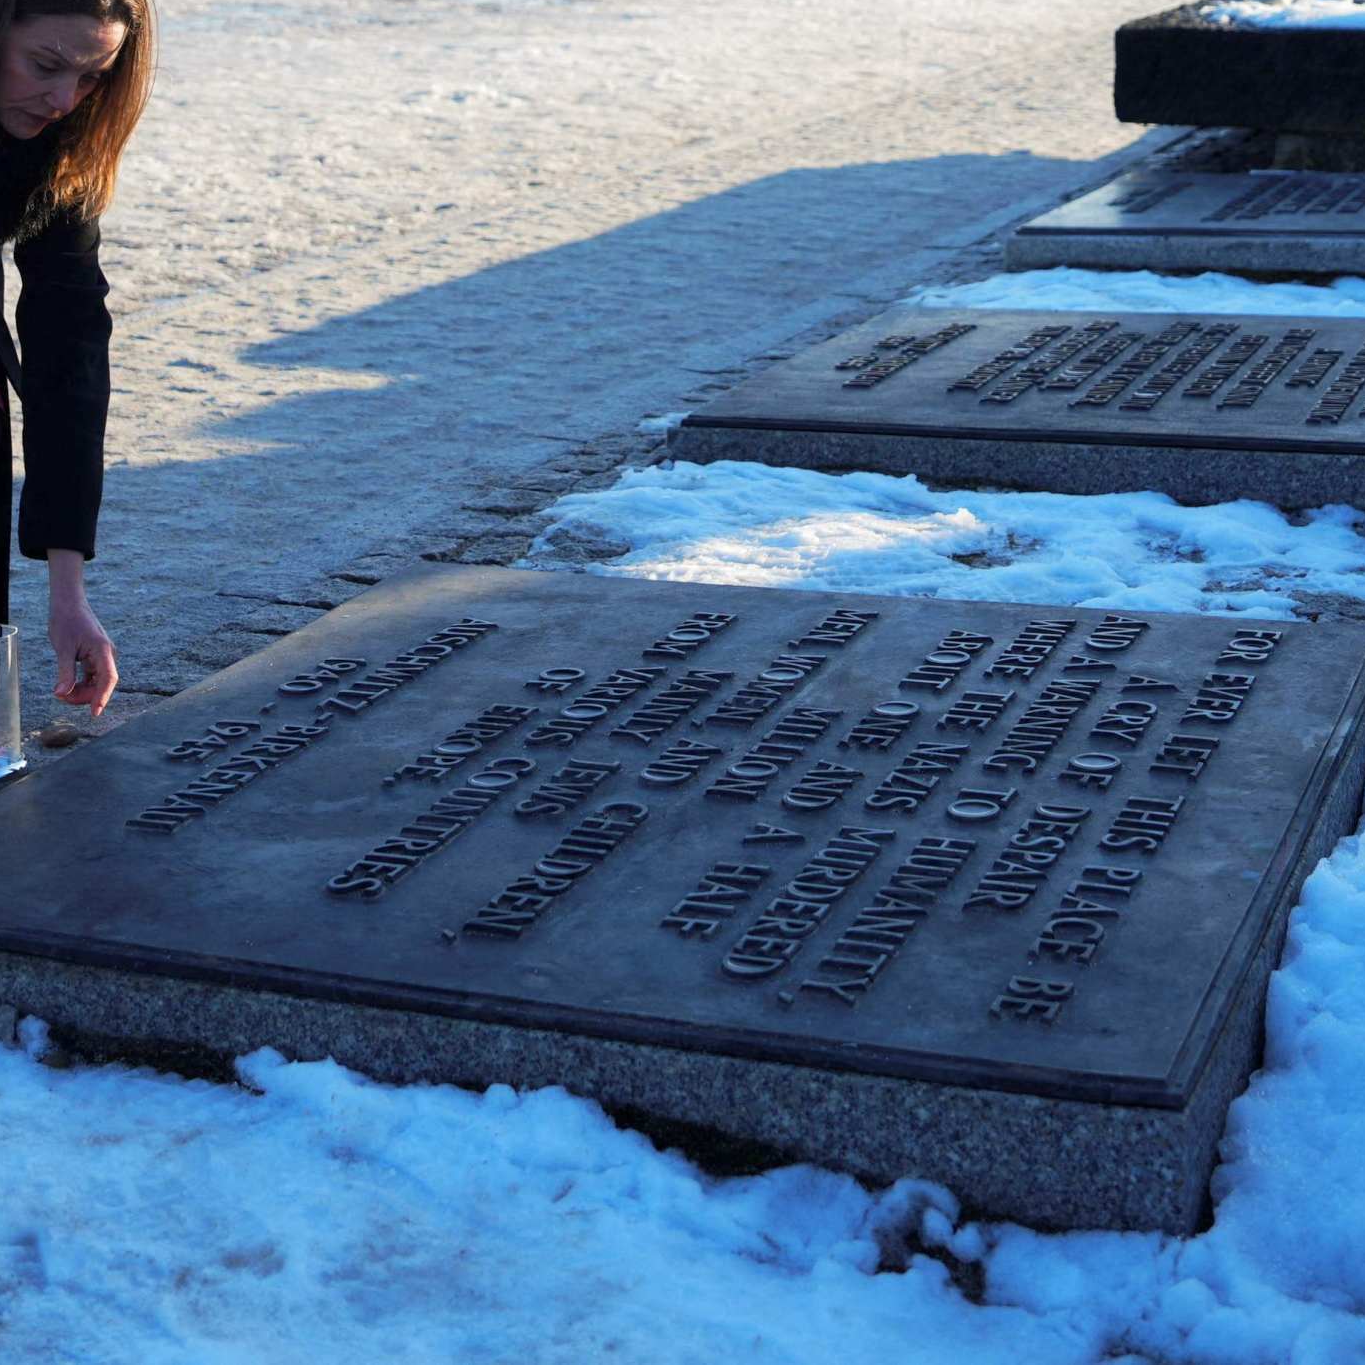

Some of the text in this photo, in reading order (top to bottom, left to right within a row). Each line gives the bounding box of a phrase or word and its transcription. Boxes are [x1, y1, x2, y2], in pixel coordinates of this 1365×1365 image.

[166, 719, 263, 763] 1945
[276, 656, 366, 695] 1940
[329, 611, 738, 898] FROM VARIOUS COUNTRIES
[381, 667, 587, 790] OF EUROPE.
[439, 609, 878, 945] MEN, WOMEN, AND CHILDREN,
[516, 668, 734, 817] MAINLY JEWS
[661, 628, 994, 938] ABOUT ONE AND A HALF
[703, 705, 844, 798] MILLION
[722, 619, 1075, 979] WHERE THE NAZIS MURDERED
[963, 675, 1177, 910] A CRY OF DESPAIR
[776, 614, 1152, 1006] AND A WARNING TO HUMANITY,
[993, 627, 1283, 1019] FOR EVER LET THIS PLACE BE
